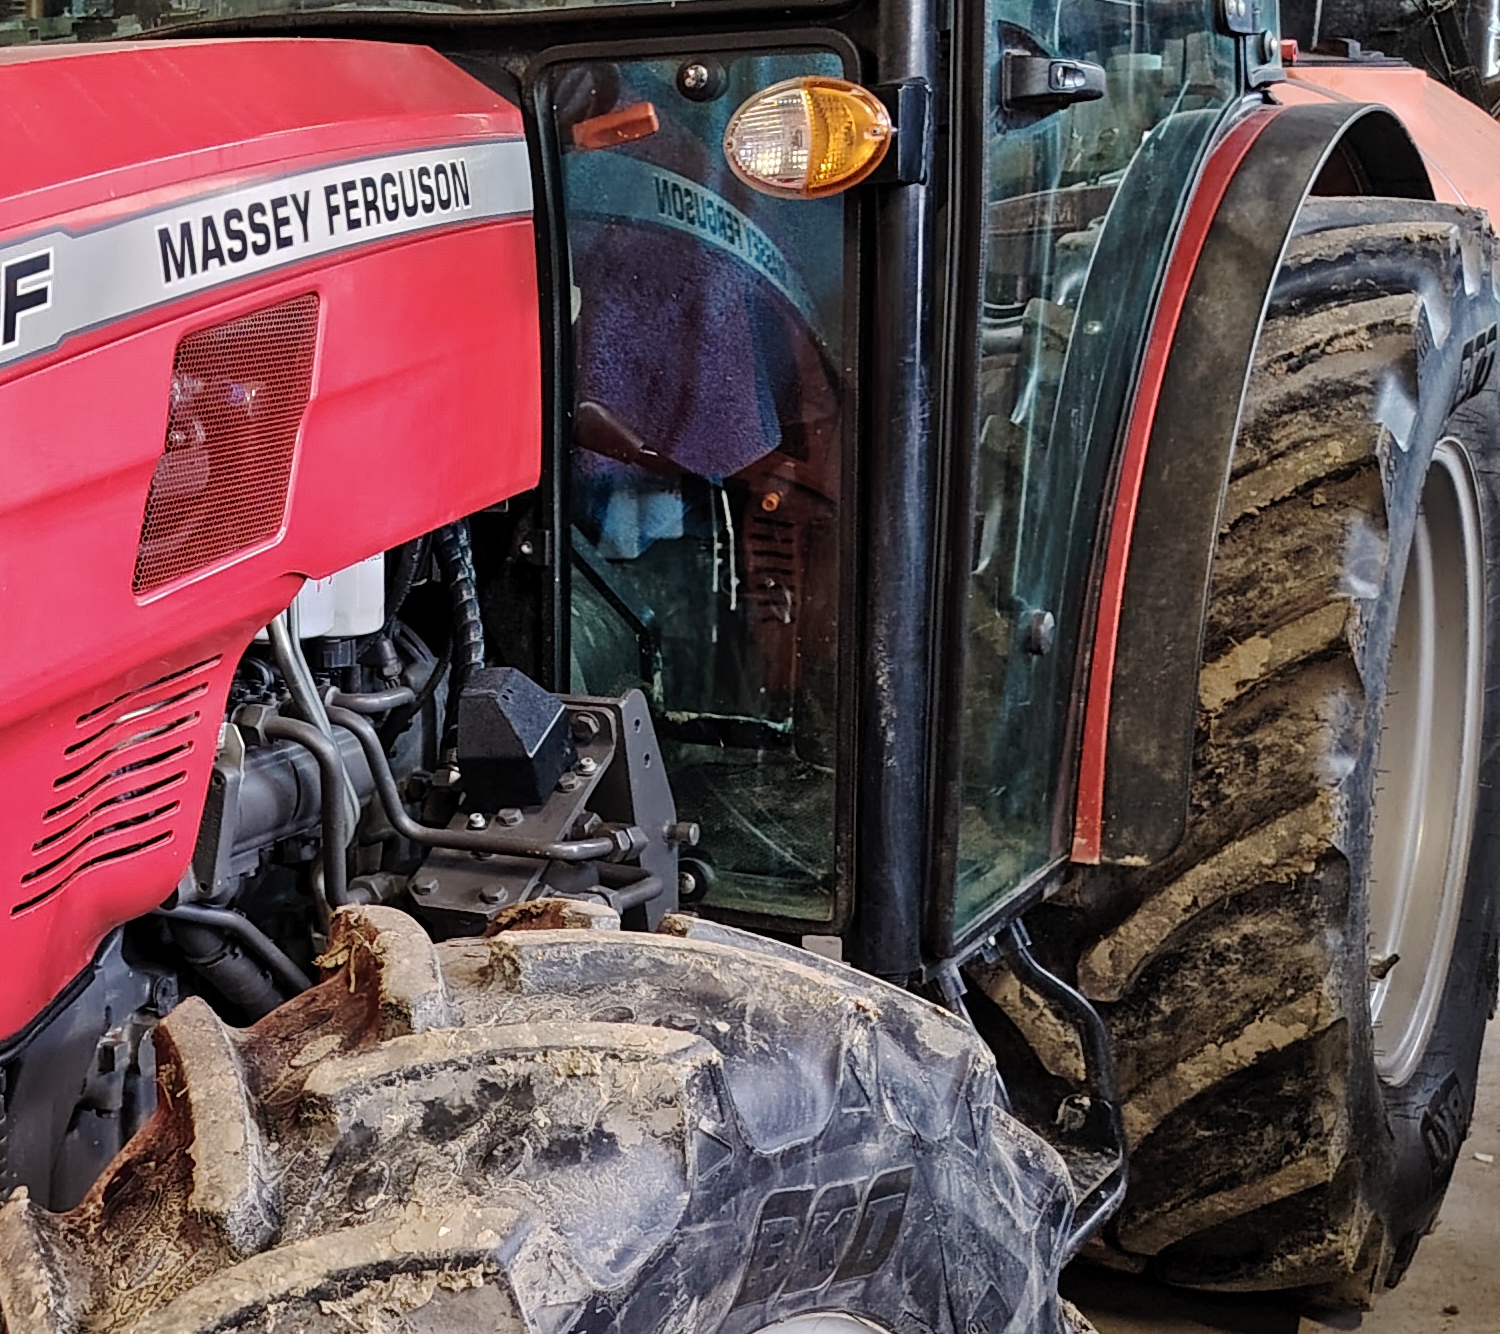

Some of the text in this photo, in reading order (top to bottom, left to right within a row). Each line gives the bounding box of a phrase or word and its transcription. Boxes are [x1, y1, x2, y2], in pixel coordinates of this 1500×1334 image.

[158, 157, 473, 285] MASSEY FERGUSON
[0, 247, 54, 353] F
[749, 1181, 910, 1280] BKT
